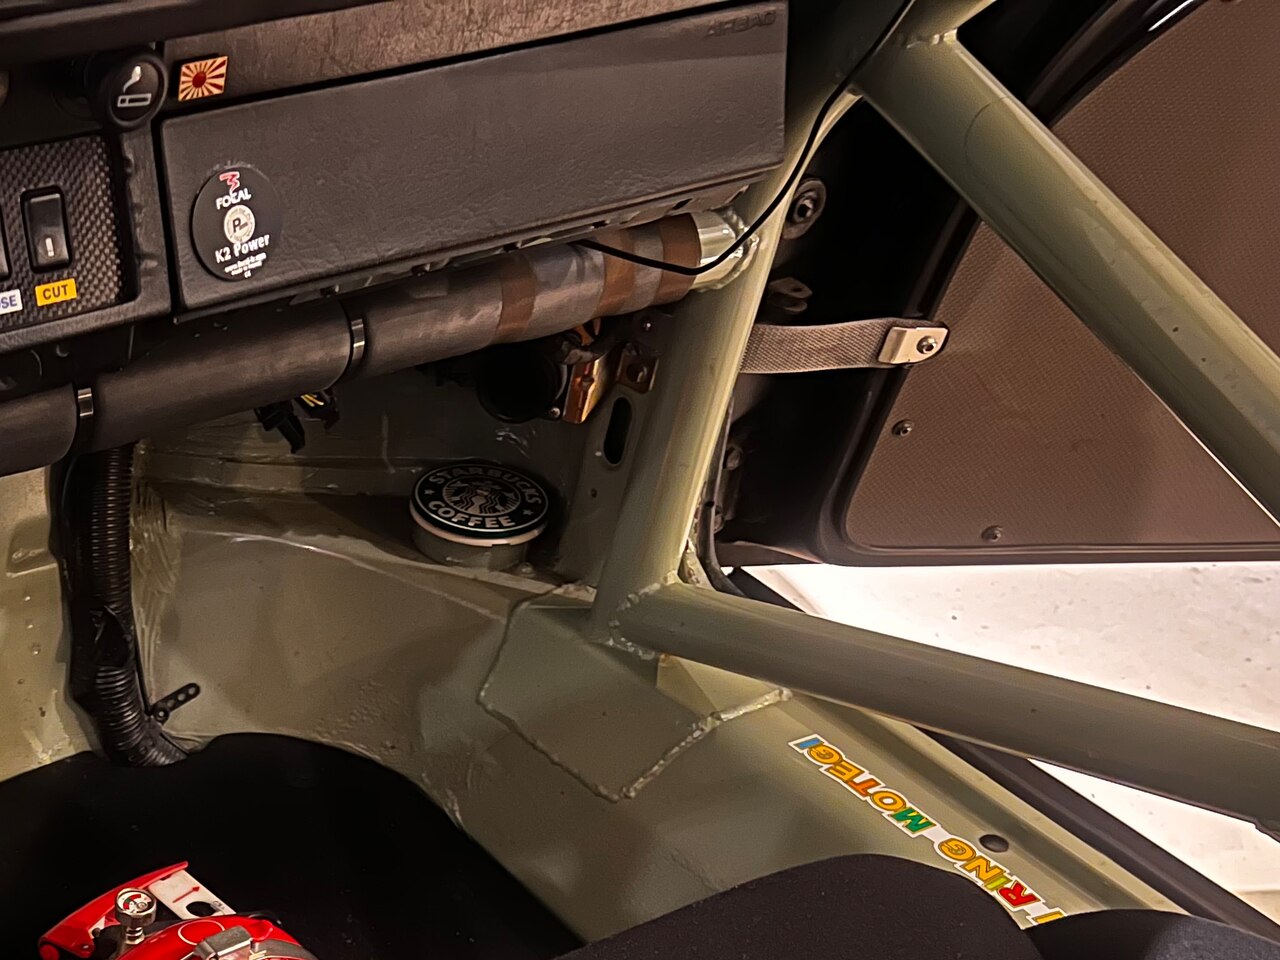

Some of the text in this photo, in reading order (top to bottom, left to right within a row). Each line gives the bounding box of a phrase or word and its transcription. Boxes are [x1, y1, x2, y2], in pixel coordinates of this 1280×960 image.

[216, 188, 251, 210] FOCAL
[215, 235, 270, 263] K2 Power
[42, 284, 69, 300] CUT
[428, 466, 542, 504] STARBUCKS
[428, 501, 516, 528] COFFEE
[798, 736, 1041, 909] RING MOTEGI
